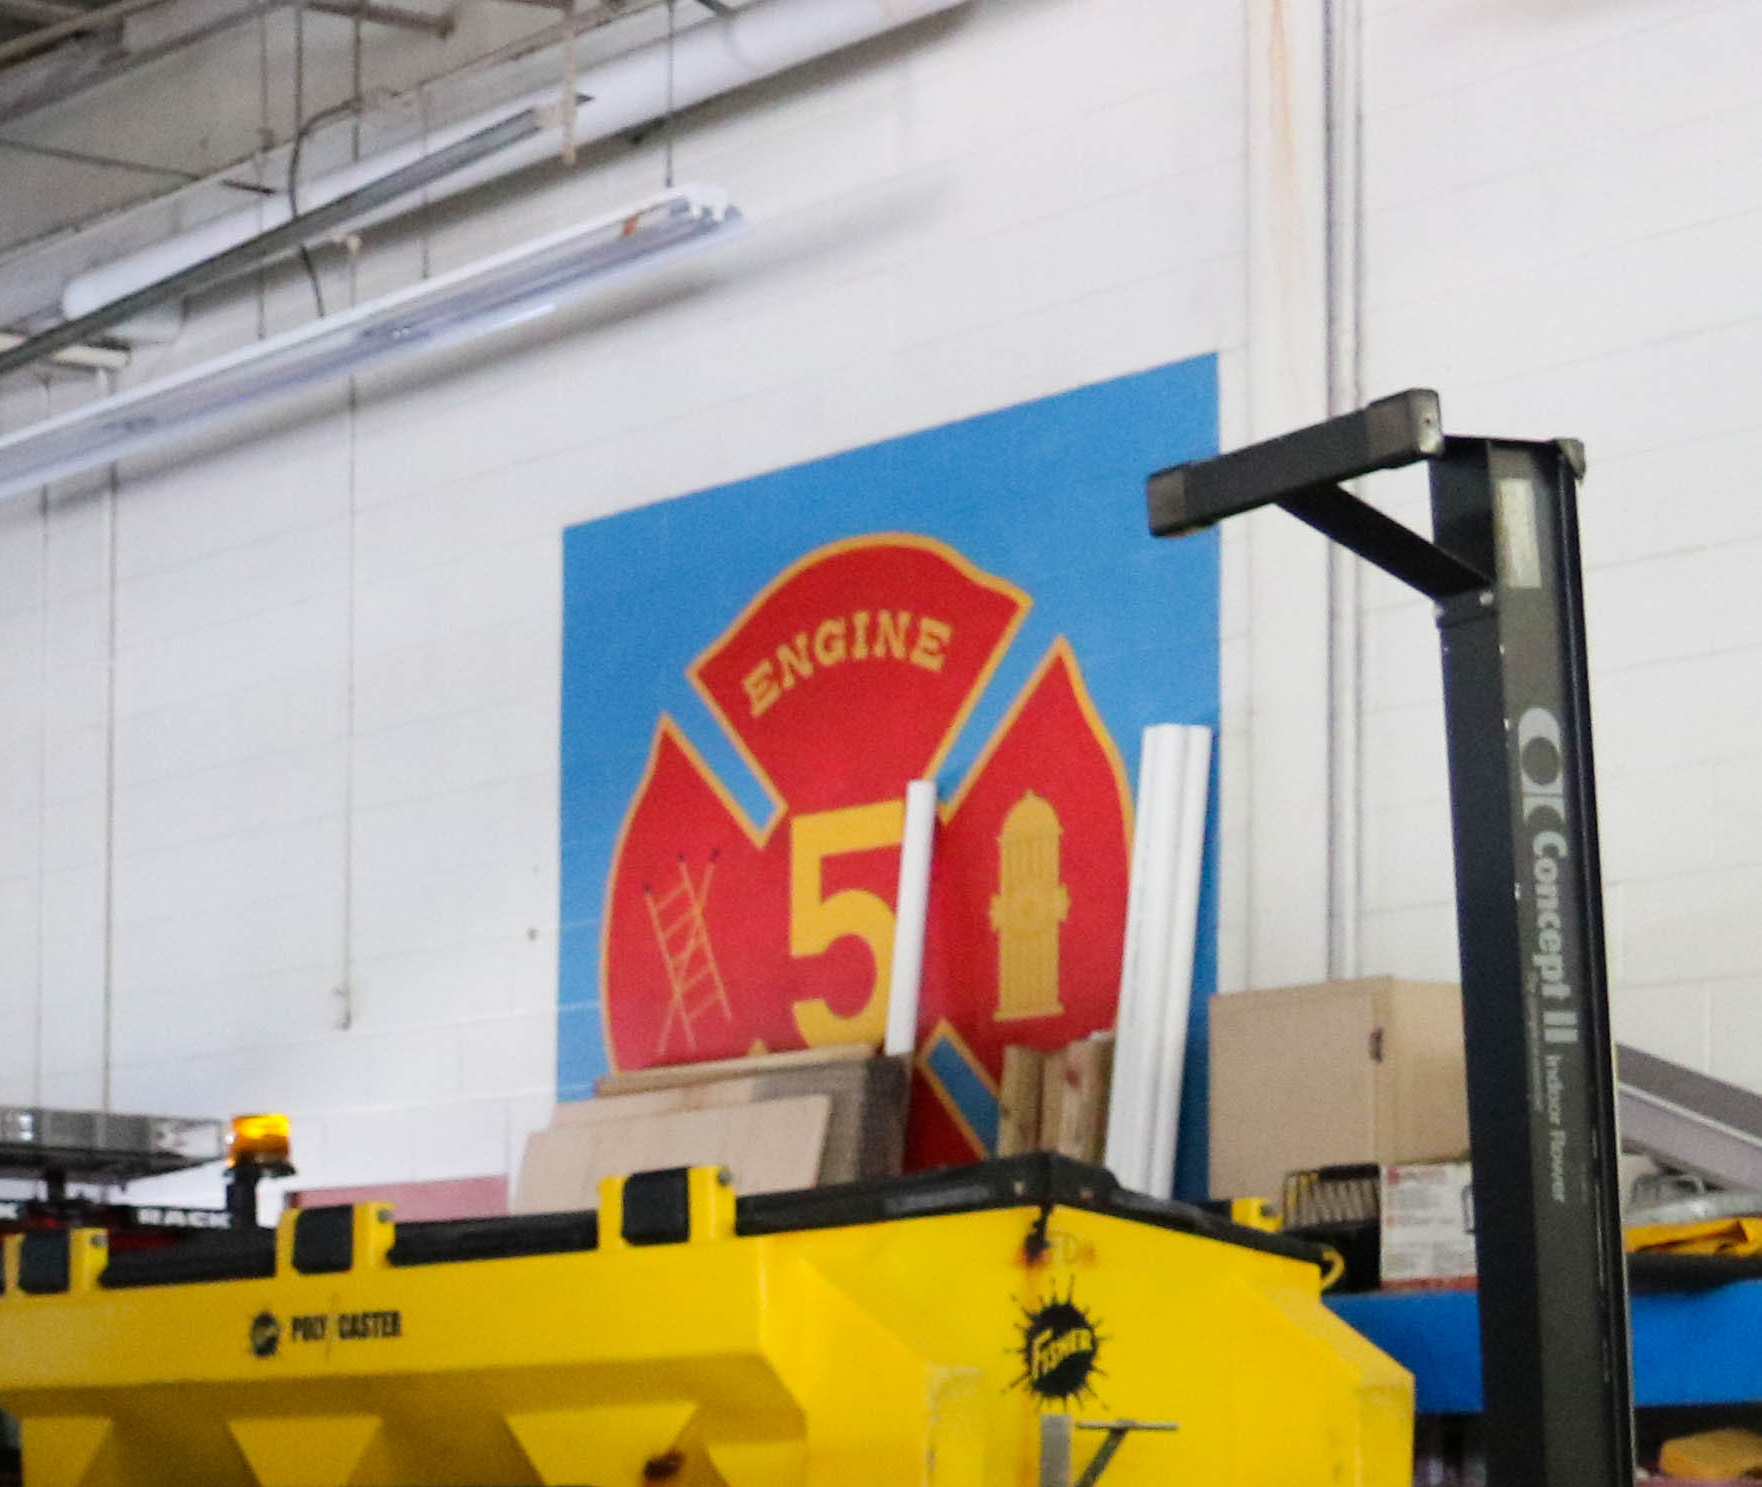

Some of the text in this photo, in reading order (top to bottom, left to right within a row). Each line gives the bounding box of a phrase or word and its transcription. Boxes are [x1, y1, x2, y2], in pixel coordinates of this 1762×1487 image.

[740, 609, 953, 718] ENGINE
[789, 799, 908, 1050] 5
[1530, 830, 1571, 999] Concept
[1543, 1010, 1578, 1043] II
[1544, 1055, 1563, 1125] Indoor
